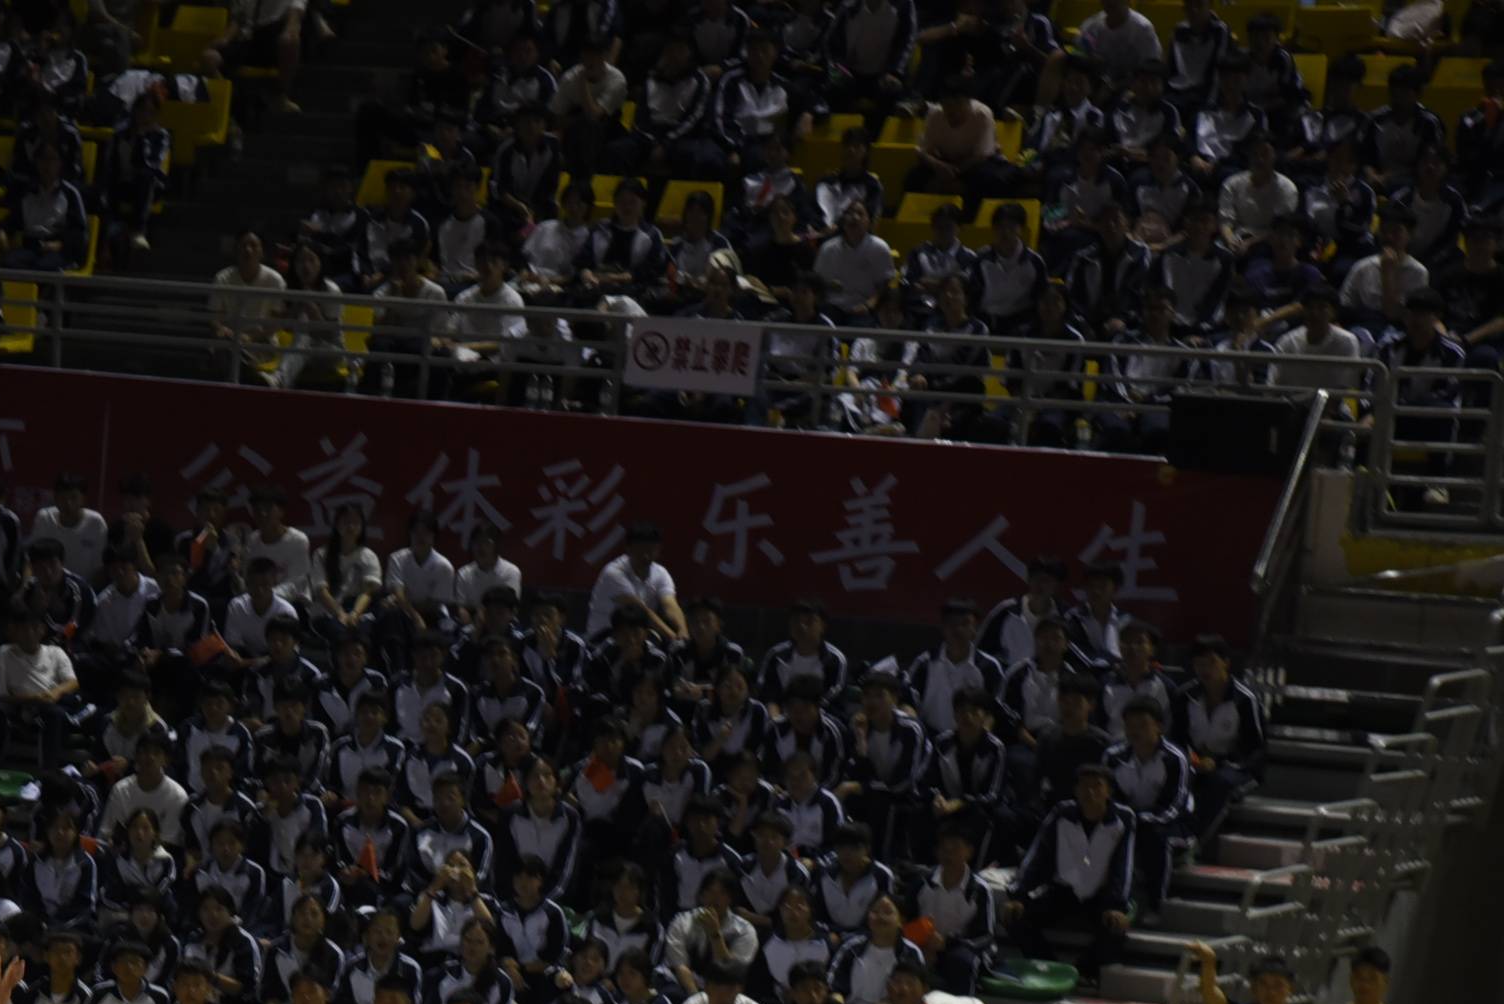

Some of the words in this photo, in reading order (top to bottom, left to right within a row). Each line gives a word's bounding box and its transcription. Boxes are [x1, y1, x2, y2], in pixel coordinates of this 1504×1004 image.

[672, 336, 751, 376] 禁止攀爬
[692, 470, 1180, 603] 乐善人生
